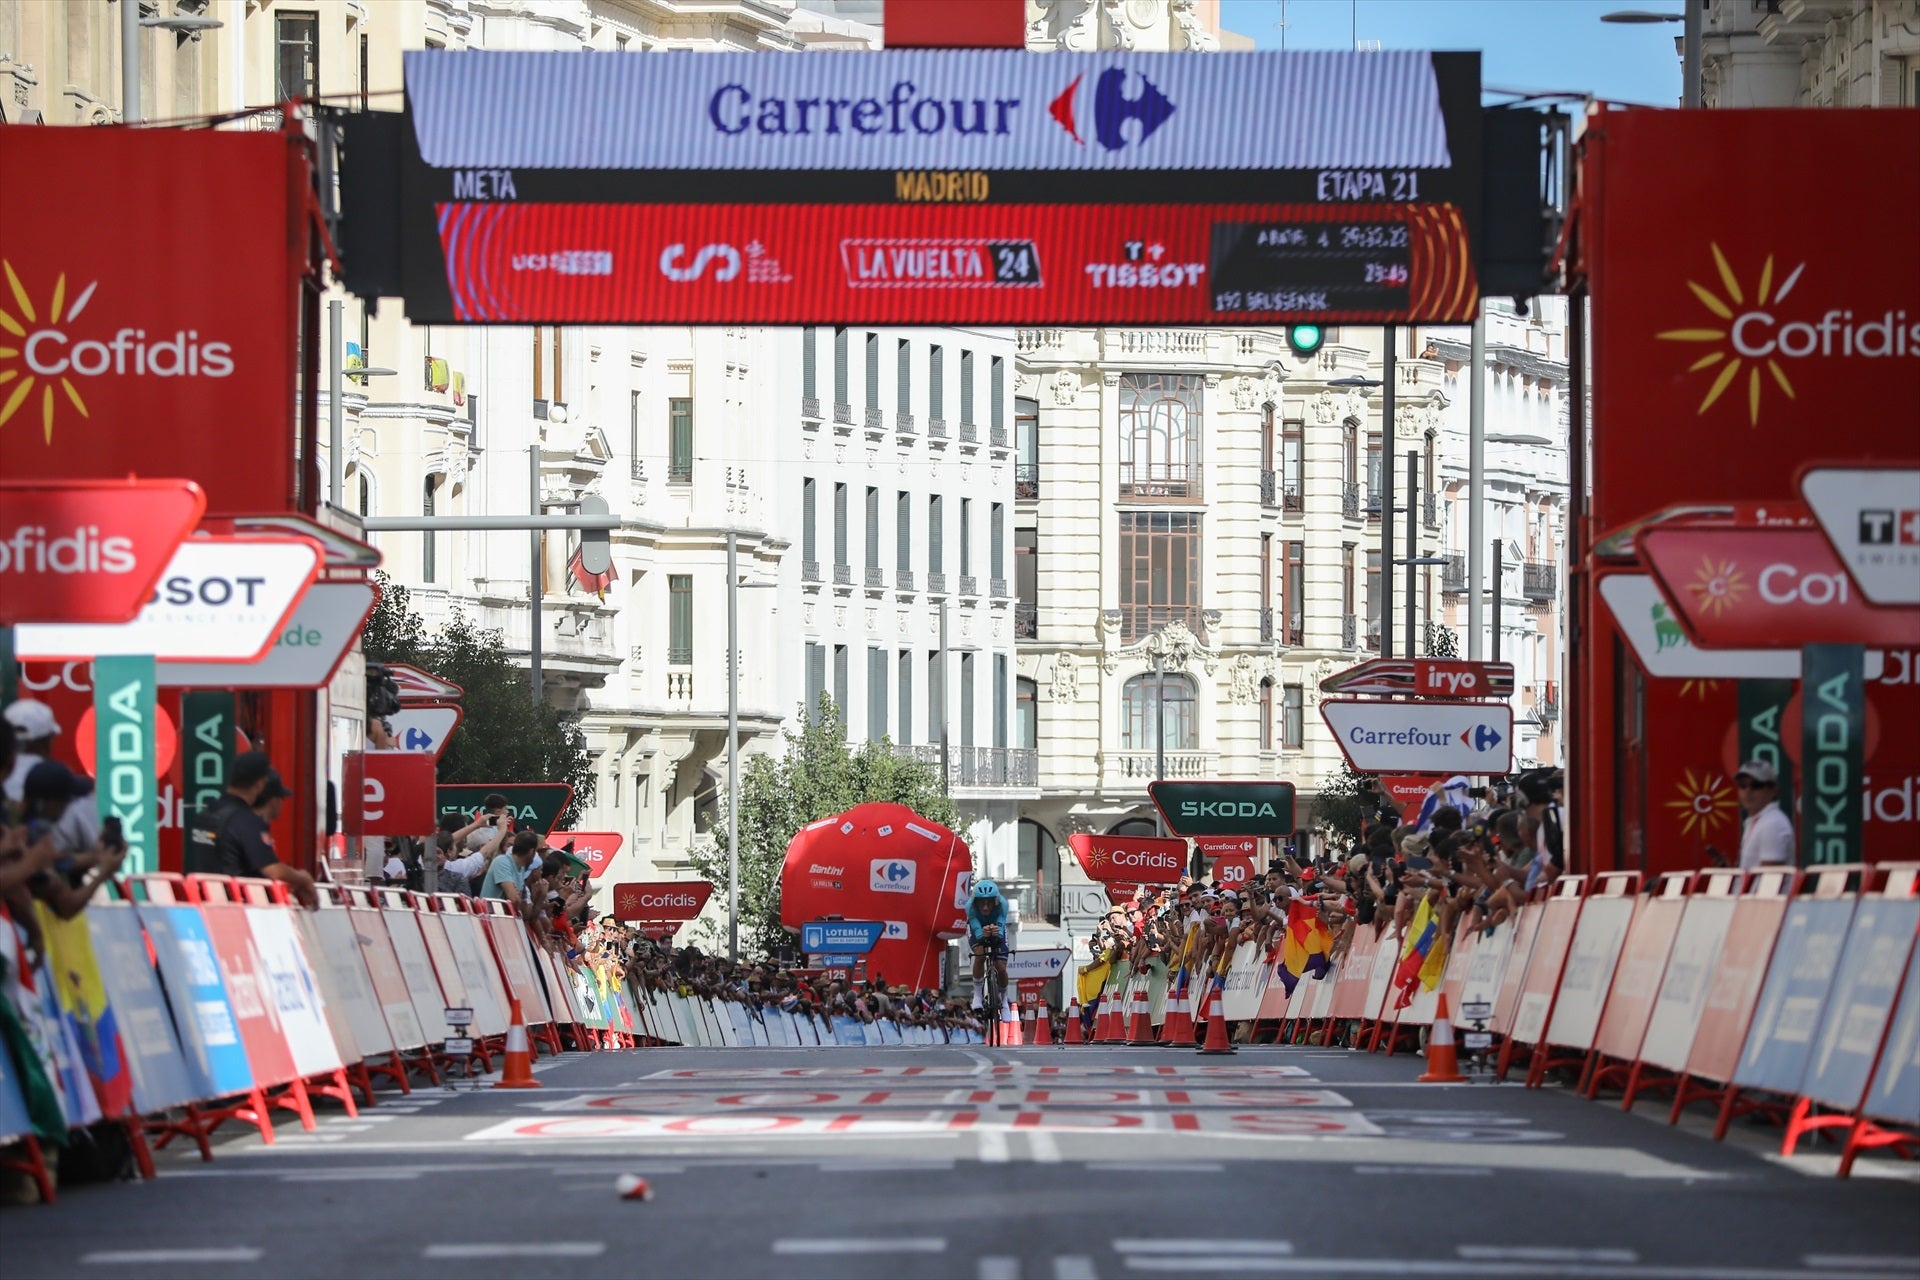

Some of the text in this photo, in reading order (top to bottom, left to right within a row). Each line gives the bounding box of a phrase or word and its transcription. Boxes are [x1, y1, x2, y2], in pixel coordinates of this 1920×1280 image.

[708, 80, 1021, 137] Carrefour
[454, 170, 517, 200] META
[896, 171, 989, 201] MADRID
[1317, 171, 1419, 201] ETAPA 21
[857, 247, 1030, 280] LA VUELTA 24
[1085, 263, 1206, 288] TISSOT
[1731, 310, 1920, 357] Cofidi
[24, 328, 235, 378] Cofidis
[1428, 665, 1476, 694] iryo
[1350, 727, 1451, 746] Carrefour
[1203, 842, 1237, 851] Carrefour
[1112, 850, 1177, 868] Cofidis
[809, 863, 844, 876] Santini
[1223, 865, 1245, 882] 50
[874, 882, 910, 891] Carrefour
[641, 893, 697, 907] Cofidis
[1008, 960, 1042, 968] arrefour
[828, 970, 846, 980] 125
[1021, 993, 1037, 1002] 150
